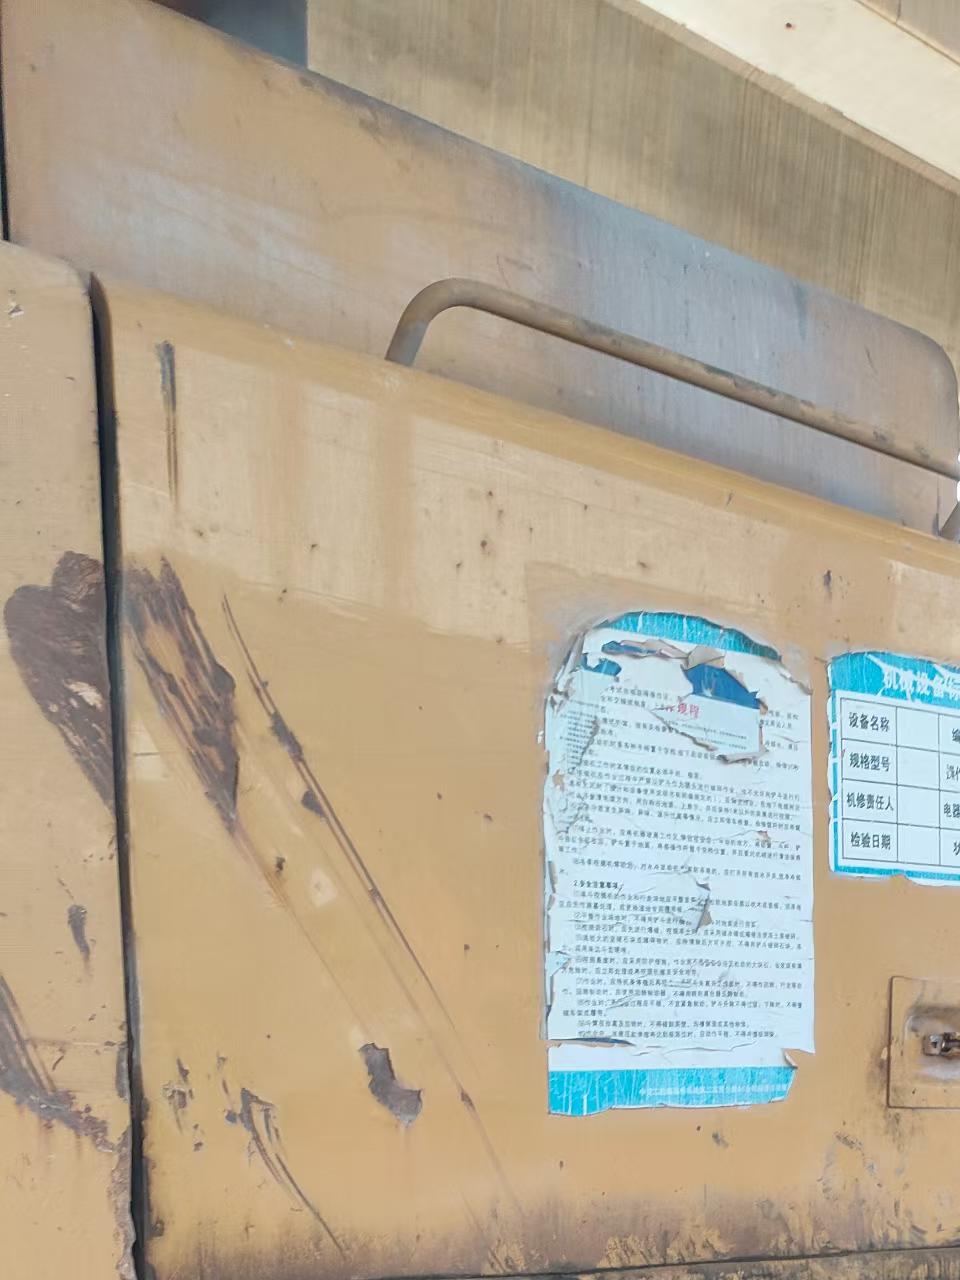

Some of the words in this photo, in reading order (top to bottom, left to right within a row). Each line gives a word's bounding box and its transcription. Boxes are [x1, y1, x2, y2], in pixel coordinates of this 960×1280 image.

[849, 711, 890, 733] 设备名称
[849, 752, 891, 772] 规格型号
[846, 792, 894, 812] 机修责任人
[850, 832, 891, 850] 检验日期
